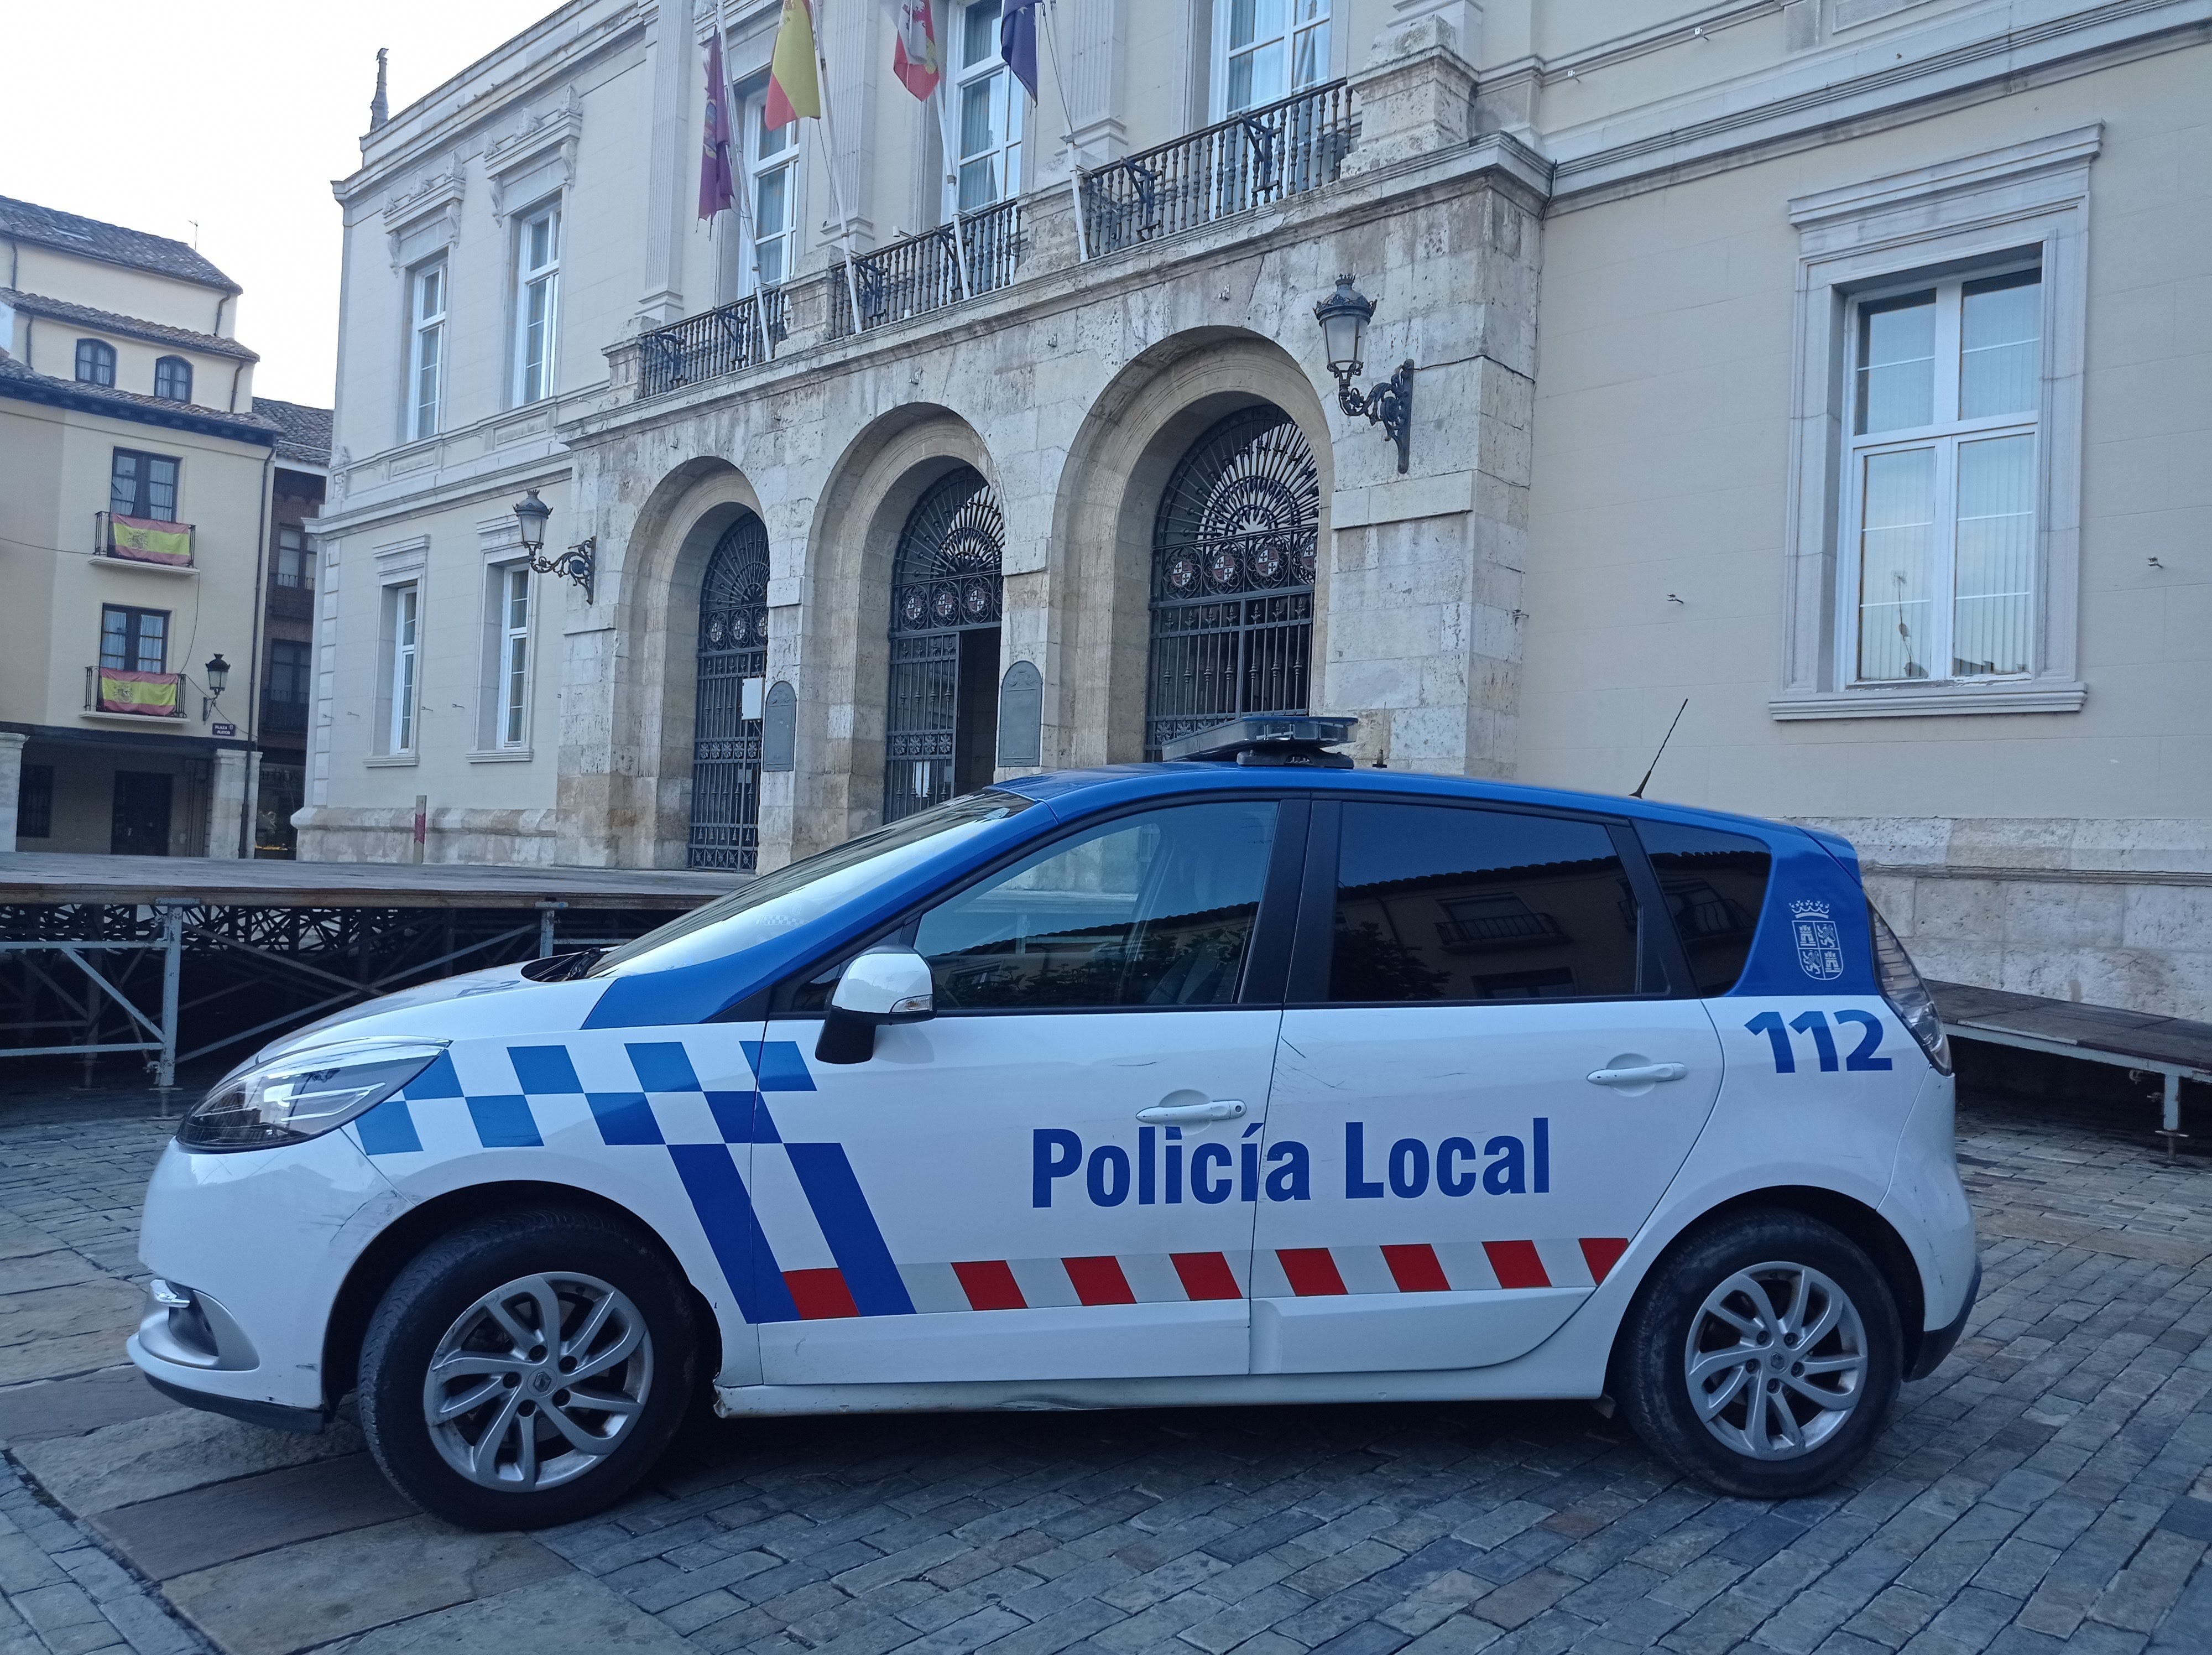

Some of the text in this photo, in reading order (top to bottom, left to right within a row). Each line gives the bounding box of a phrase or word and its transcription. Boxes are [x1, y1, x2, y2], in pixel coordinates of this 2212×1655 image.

[1744, 1009, 1893, 1073] 112
[1033, 1118, 1550, 1209] Policía Local
